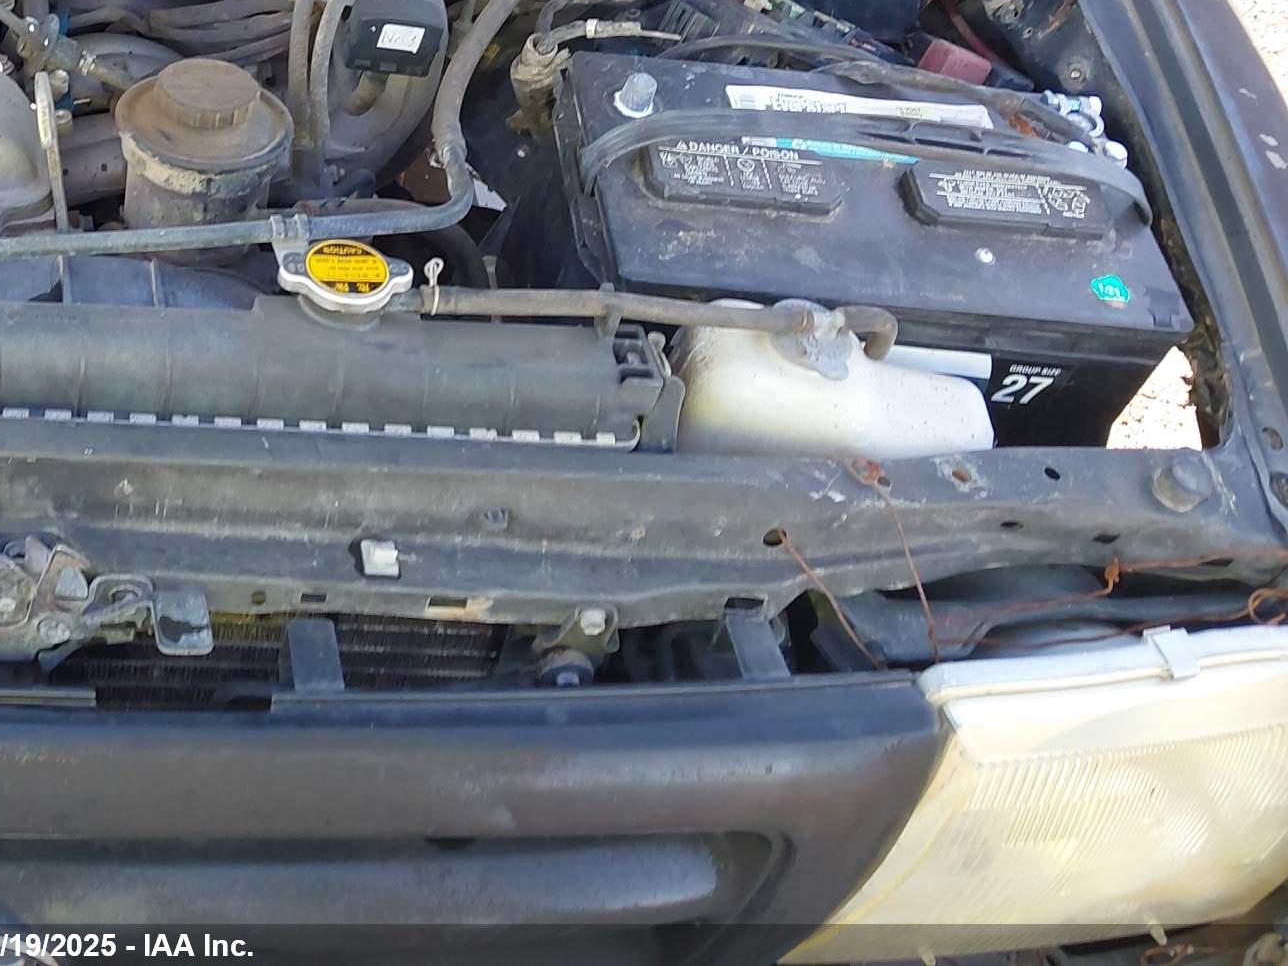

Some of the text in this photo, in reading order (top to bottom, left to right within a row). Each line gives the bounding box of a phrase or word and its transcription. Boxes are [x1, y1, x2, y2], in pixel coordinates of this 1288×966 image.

[688, 141, 740, 155] DANGER
[751, 147, 800, 161] POISON
[323, 246, 362, 254] CAUTION
[1009, 364, 1041, 374] GROUP
[990, 374, 1055, 405] 27
